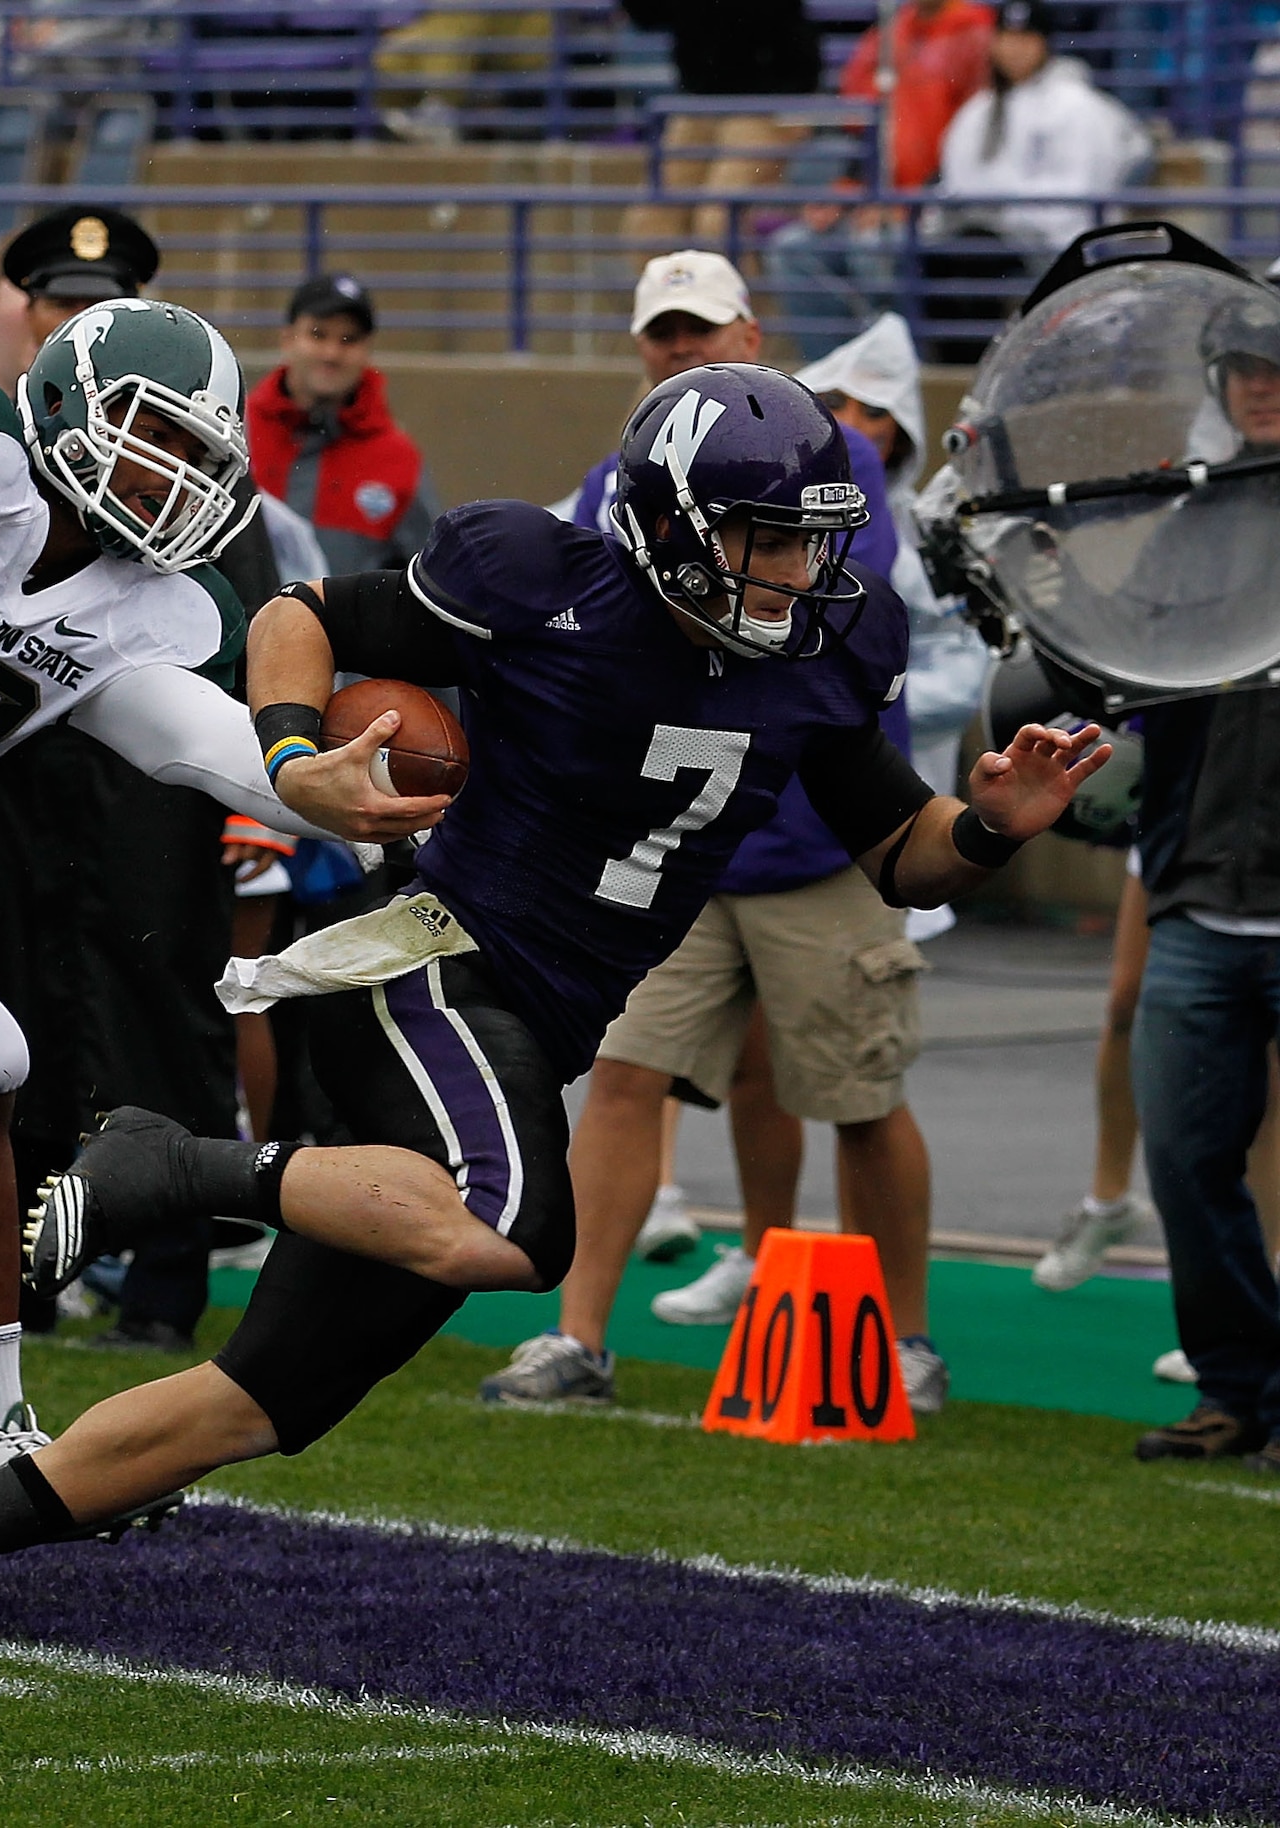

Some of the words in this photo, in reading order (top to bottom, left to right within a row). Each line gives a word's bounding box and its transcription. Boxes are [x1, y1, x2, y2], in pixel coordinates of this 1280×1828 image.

[647, 388, 728, 478] N
[17, 635, 95, 692] STATE
[545, 619, 582, 631] adidas
[594, 723, 752, 909] 7
[409, 906, 441, 938] adidas
[719, 1286, 794, 1422] 10
[812, 1291, 891, 1428] 10
